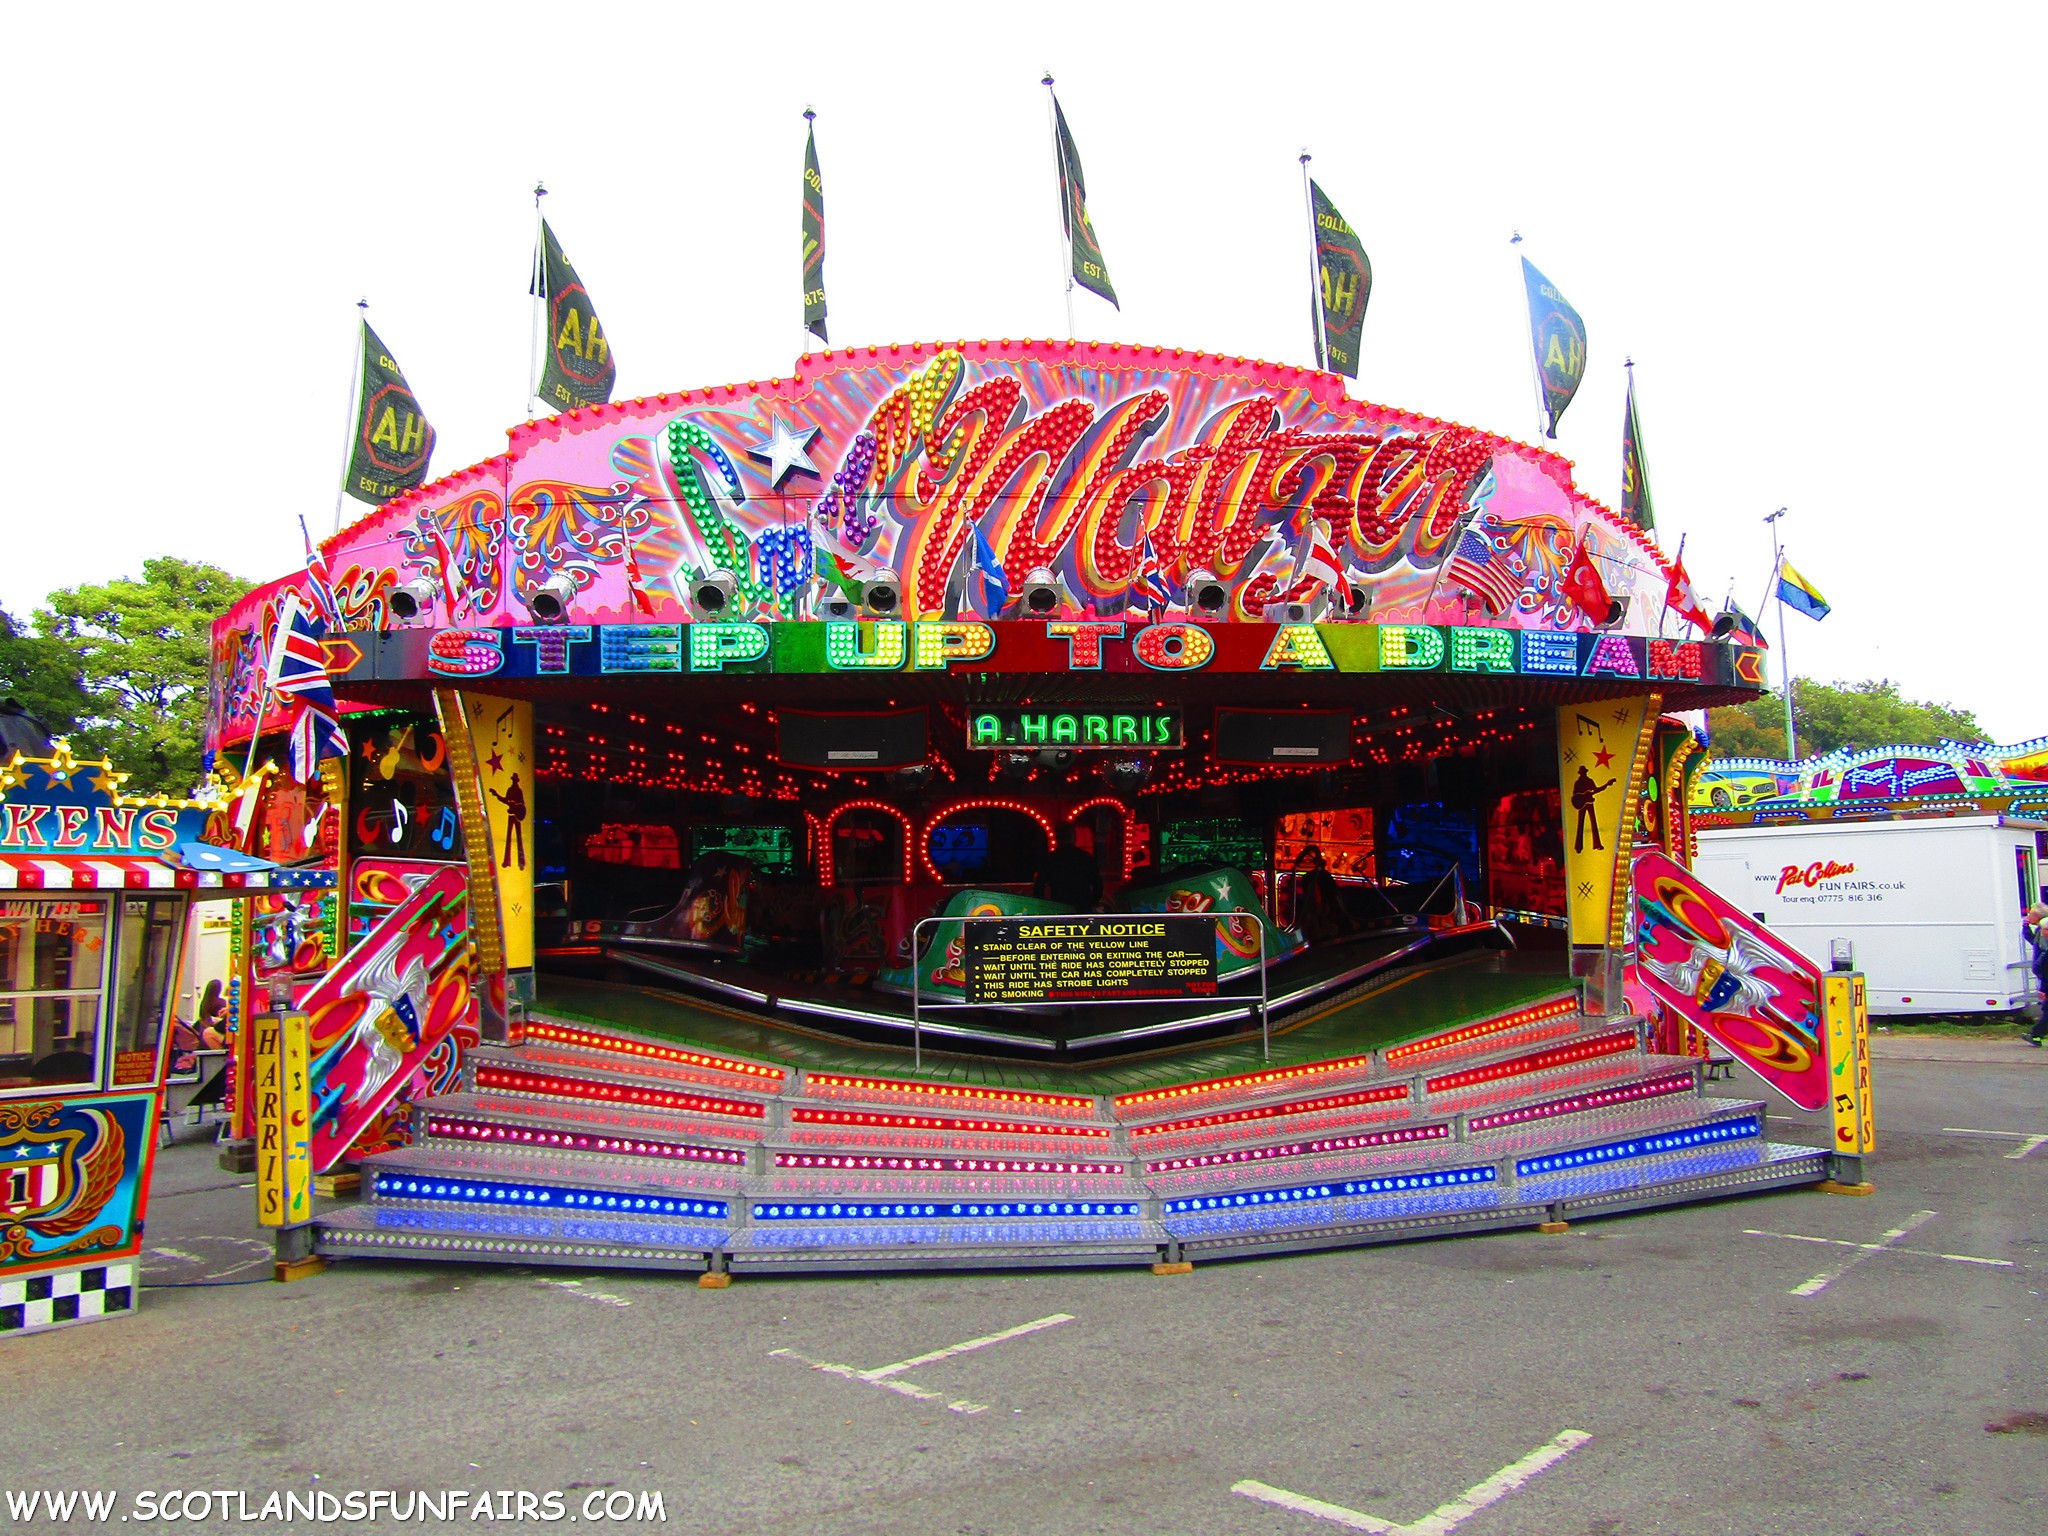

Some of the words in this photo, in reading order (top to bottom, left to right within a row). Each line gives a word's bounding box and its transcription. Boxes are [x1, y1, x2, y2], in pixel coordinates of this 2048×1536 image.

[1083, 261, 1101, 279] EST
[1320, 265, 1359, 317] AH
[557, 308, 608, 364] AH
[1544, 333, 1583, 381] AH
[555, 383, 571, 403] EST
[371, 406, 425, 454] AH
[360, 476, 378, 493] EST
[427, 623, 772, 678] STEP
[825, 622, 996, 673] UP
[1047, 622, 1215, 672] TO
[1259, 624, 1340, 673] A
[1378, 624, 1702, 684] DREAM
[1022, 714, 1172, 744] HARRIS
[1775, 865, 1804, 895] Pat
[1803, 860, 1855, 888] Collins
[1819, 882, 1841, 891] FUN
[1844, 881, 1905, 890] FAIRS.co.uk
[1848, 894, 1864, 902] 816
[1867, 894, 1883, 902] 316
[5, 901, 81, 918] WALTZER
[35, 919, 104, 953] HERE
[1019, 925, 1090, 937] SAFETY
[1100, 923, 1166, 936] NOTICE
[983, 943, 1012, 951] STAND
[1016, 943, 1047, 951] CLEAR
[1050, 942, 1063, 950] OF
[1067, 942, 1085, 950] THE
[1089, 941, 1125, 949] YELLOW
[983, 963, 1006, 971] WAIT
[1010, 963, 1037, 971] UNTIL
[1039, 962, 1057, 970] THE
[1086, 961, 1105, 969] HAS
[1108, 960, 1166, 968] COMPLETELY
[1170, 959, 1210, 967] STOPPED
[1000, 954, 1036, 962] BEFORE
[1040, 953, 1086, 961] ENTERING
[1089, 952, 1103, 960] OR
[1145, 951, 1163, 959] THE
[983, 972, 1006, 980] WAIT
[1010, 972, 1037, 980] UNTIL
[1039, 971, 1057, 979] THE
[1084, 970, 1103, 978] HAS
[1106, 969, 1164, 977] COMPLETELY
[1167, 968, 1207, 976] STOPPED
[1009, 981, 1030, 989] RIDE
[1034, 980, 1053, 988] HAS
[1056, 979, 1093, 988] STROBE
[984, 991, 998, 999] NO
[1001, 990, 1044, 998] SMOKING
[118, 1052, 151, 1063] NOTICE
[1854, 984, 1872, 1144] HARRIS
[257, 1029, 279, 1214] HARRIS
[5, 1168, 33, 1206] 1
